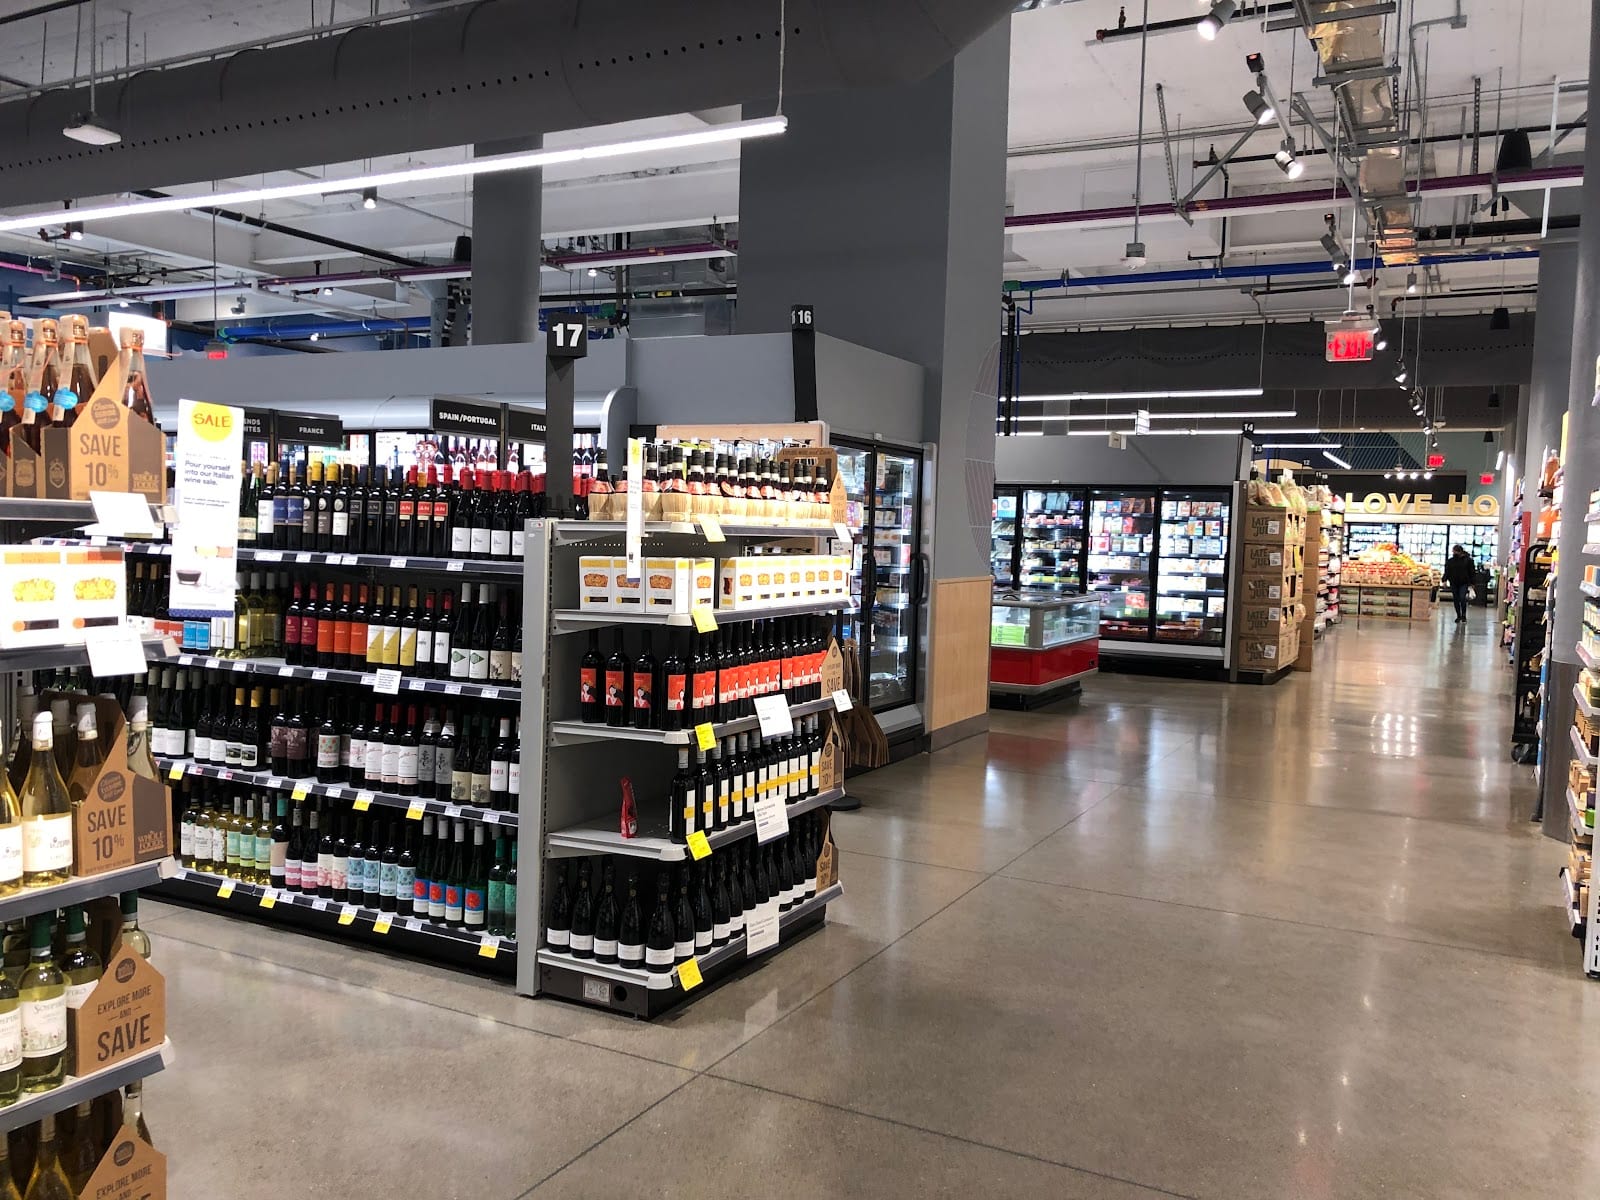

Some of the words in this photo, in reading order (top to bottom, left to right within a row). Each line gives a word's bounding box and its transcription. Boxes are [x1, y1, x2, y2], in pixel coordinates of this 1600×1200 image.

[797, 309, 812, 325] 16
[552, 322, 583, 347] 17
[193, 413, 231, 428] SALE
[299, 426, 325, 435] FRANCE
[531, 423, 547, 432] ITALY
[1243, 423, 1254, 432] 14
[80, 433, 121, 457] SAVE
[85, 462, 119, 487] 10%
[184, 460, 201, 468] Pour
[203, 464, 231, 472] yourself
[1344, 492, 1433, 515] LOVE
[87, 804, 127, 833] SAVE
[92, 833, 125, 861] 10%
[97, 993, 131, 1016] EXPLORE
[131, 984, 152, 1001] MORE
[119, 1007, 132, 1019] AND
[97, 1013, 152, 1062] SAVE
[96, 1175, 130, 1200] EXPLORE
[131, 1163, 153, 1182] MORE
